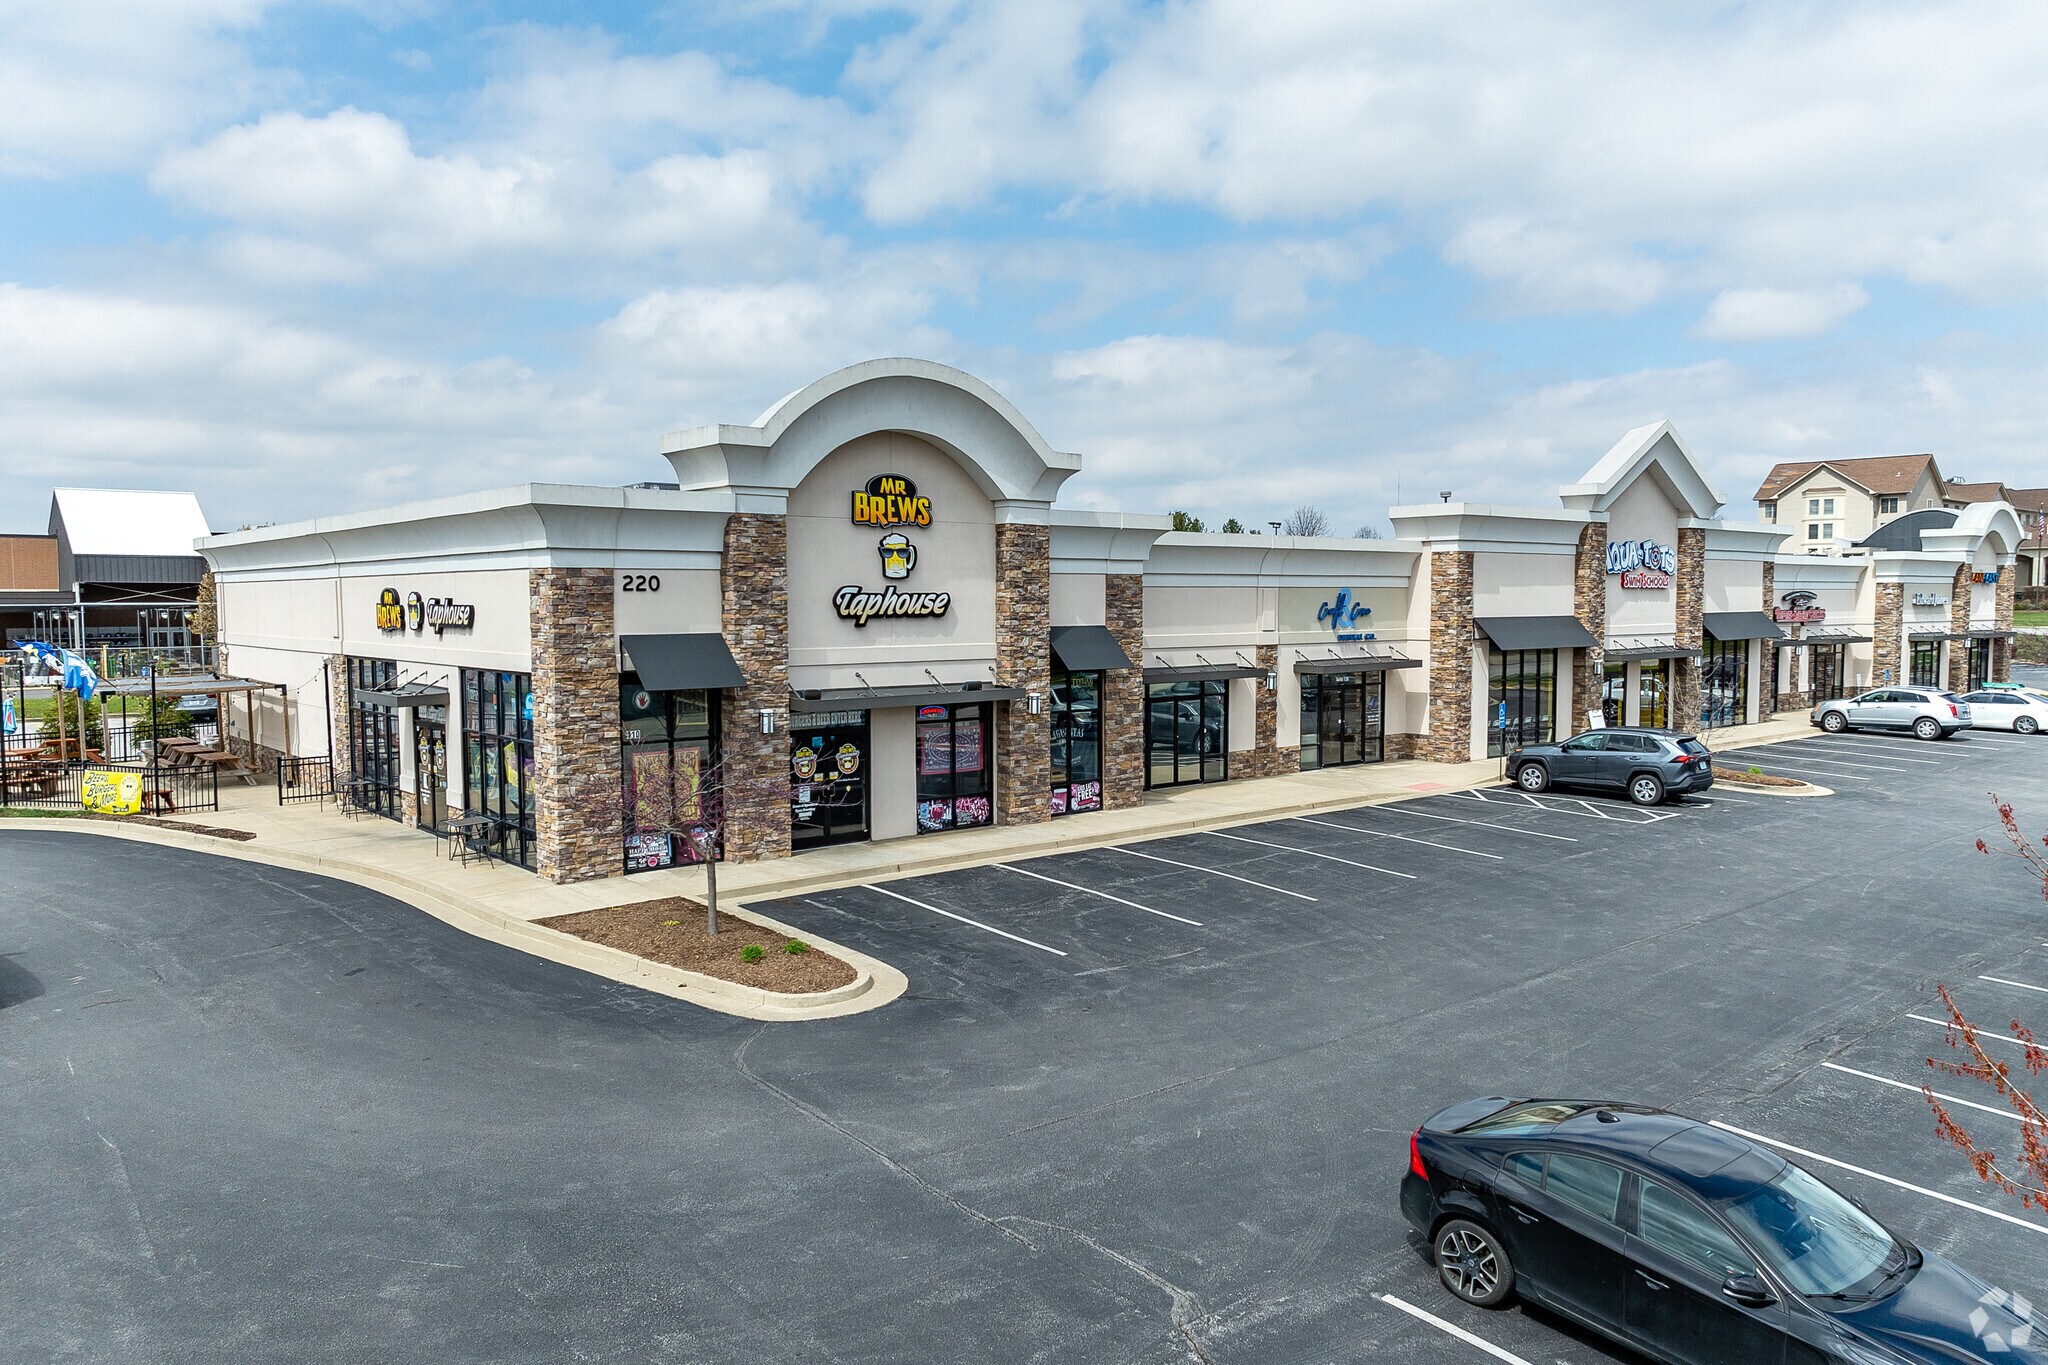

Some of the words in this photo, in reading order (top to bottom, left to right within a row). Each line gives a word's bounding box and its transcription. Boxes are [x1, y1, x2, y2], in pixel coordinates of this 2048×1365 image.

[880, 477, 906, 496] MR
[855, 492, 931, 526] BREWS
[622, 575, 660, 591] 220
[383, 591, 393, 605] MR
[836, 586, 950, 624] Taphouse
[376, 604, 402, 630] BREWS
[427, 598, 470, 632] Taphouse
[1078, 788, 1094, 802] FREE
